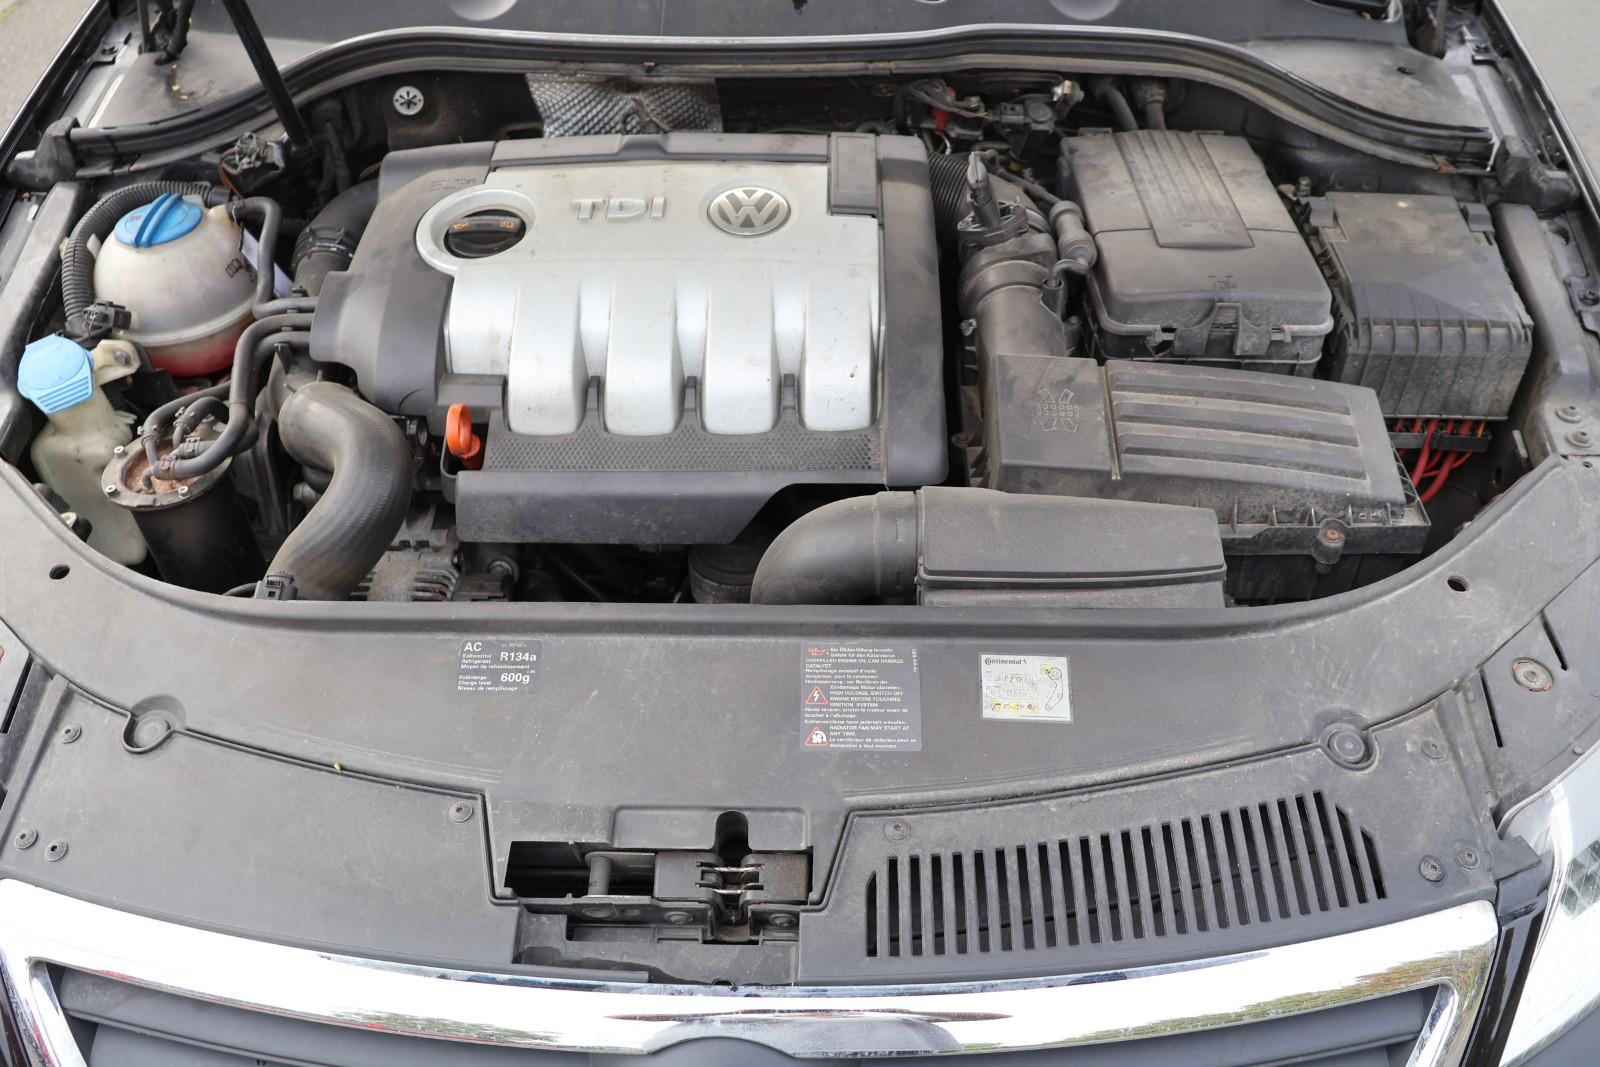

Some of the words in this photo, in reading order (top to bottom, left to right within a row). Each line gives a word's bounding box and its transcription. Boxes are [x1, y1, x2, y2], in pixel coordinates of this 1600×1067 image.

[569, 197, 666, 221] TDI
[464, 642, 482, 651] AC
[500, 652, 536, 661] R134a
[985, 657, 1021, 665] Continental
[501, 673, 530, 684] 600g
